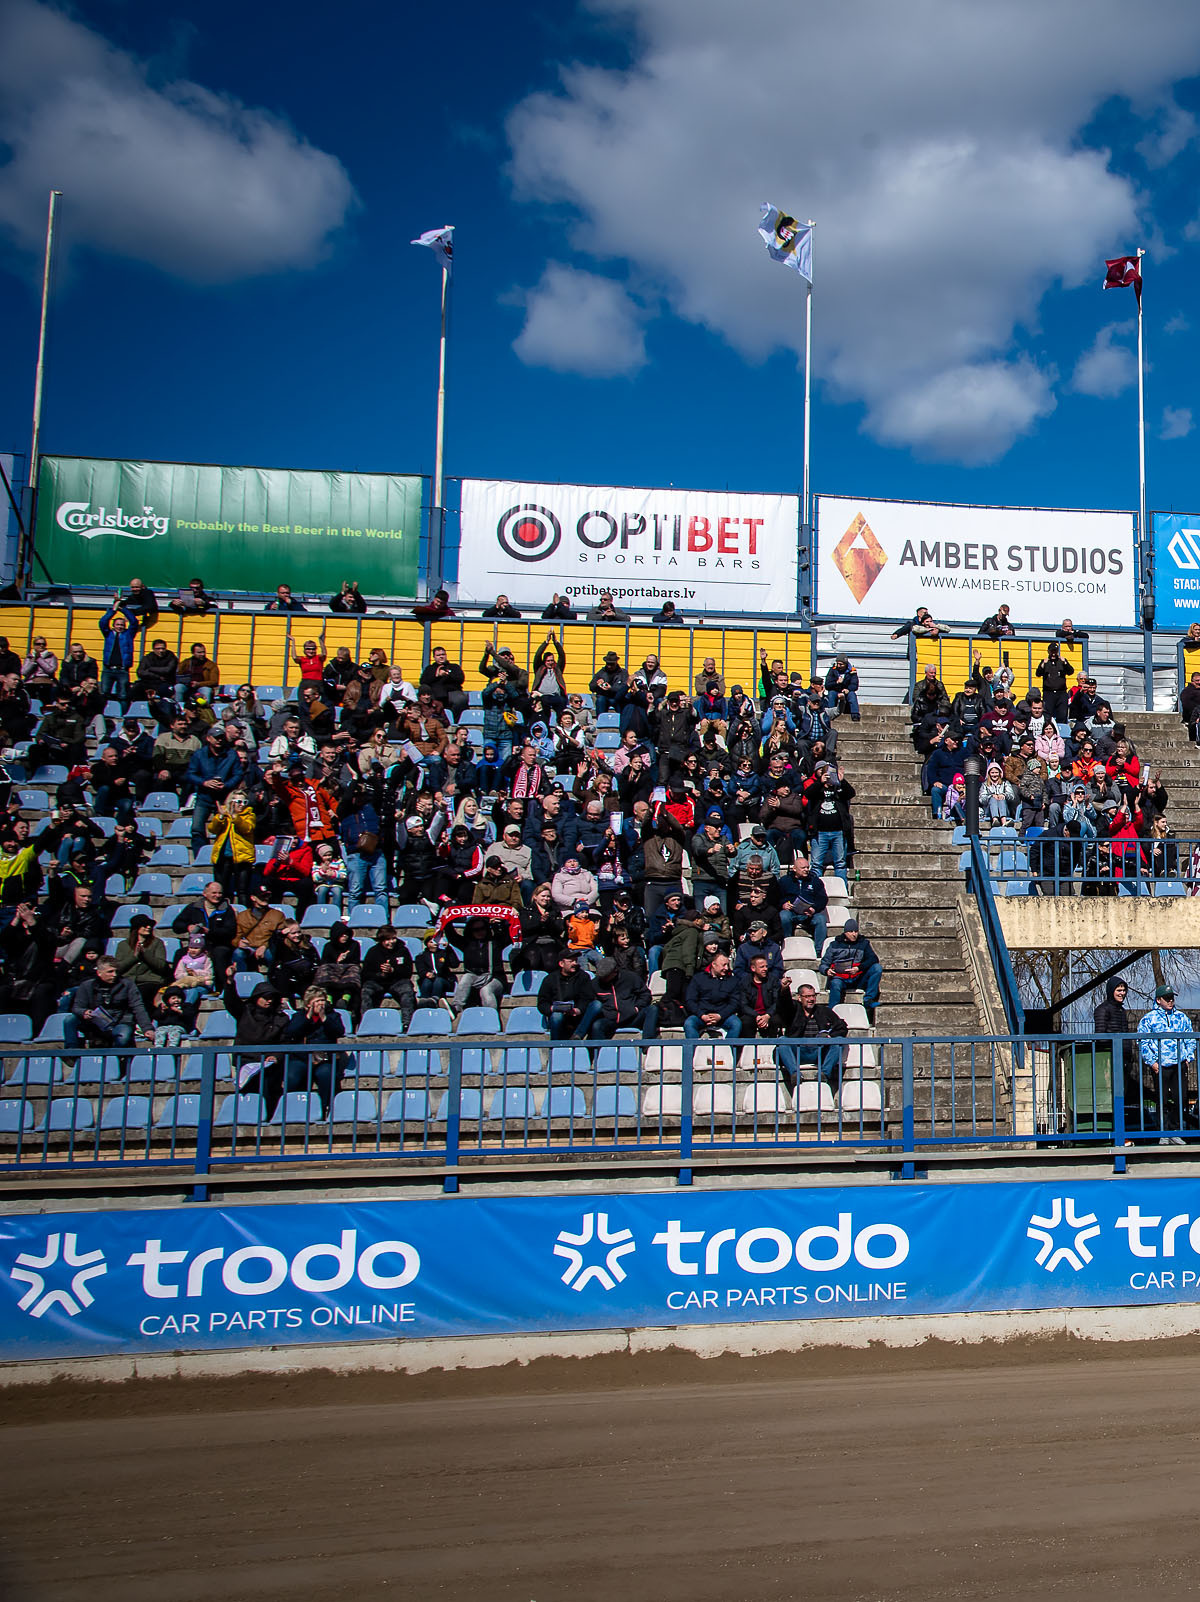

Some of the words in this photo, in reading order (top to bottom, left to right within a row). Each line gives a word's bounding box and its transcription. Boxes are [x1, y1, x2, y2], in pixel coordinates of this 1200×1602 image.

[56, 502, 170, 539] Carlsberg
[176, 519, 235, 533] Probably
[238, 521, 259, 533] the
[262, 523, 290, 534] Best
[294, 525, 324, 535] Beer
[327, 526, 339, 536] in
[341, 526, 362, 537] the
[365, 528, 403, 539] World
[576, 510, 764, 555] OPTIBET
[579, 553, 678, 566] SPORTA
[698, 557, 760, 570] BĀRS
[899, 539, 999, 571] AMBER
[1007, 545, 1124, 575] STUDIOS
[565, 584, 696, 600] optibetsportabars.lv
[920, 576, 1106, 594] WWW.AMBER-STUDIOS.COM
[445, 906, 513, 919] OKOMOT
[652, 1212, 910, 1275] trodo
[126, 1229, 420, 1299] trodo
[1129, 1271, 1176, 1290] CAR
[666, 1289, 719, 1310] CAR
[727, 1286, 808, 1307] PARTS
[815, 1282, 907, 1304] ONLINE
[140, 1313, 200, 1336] CAR
[209, 1307, 303, 1332] PARTS
[311, 1302, 416, 1326] ONLINE
